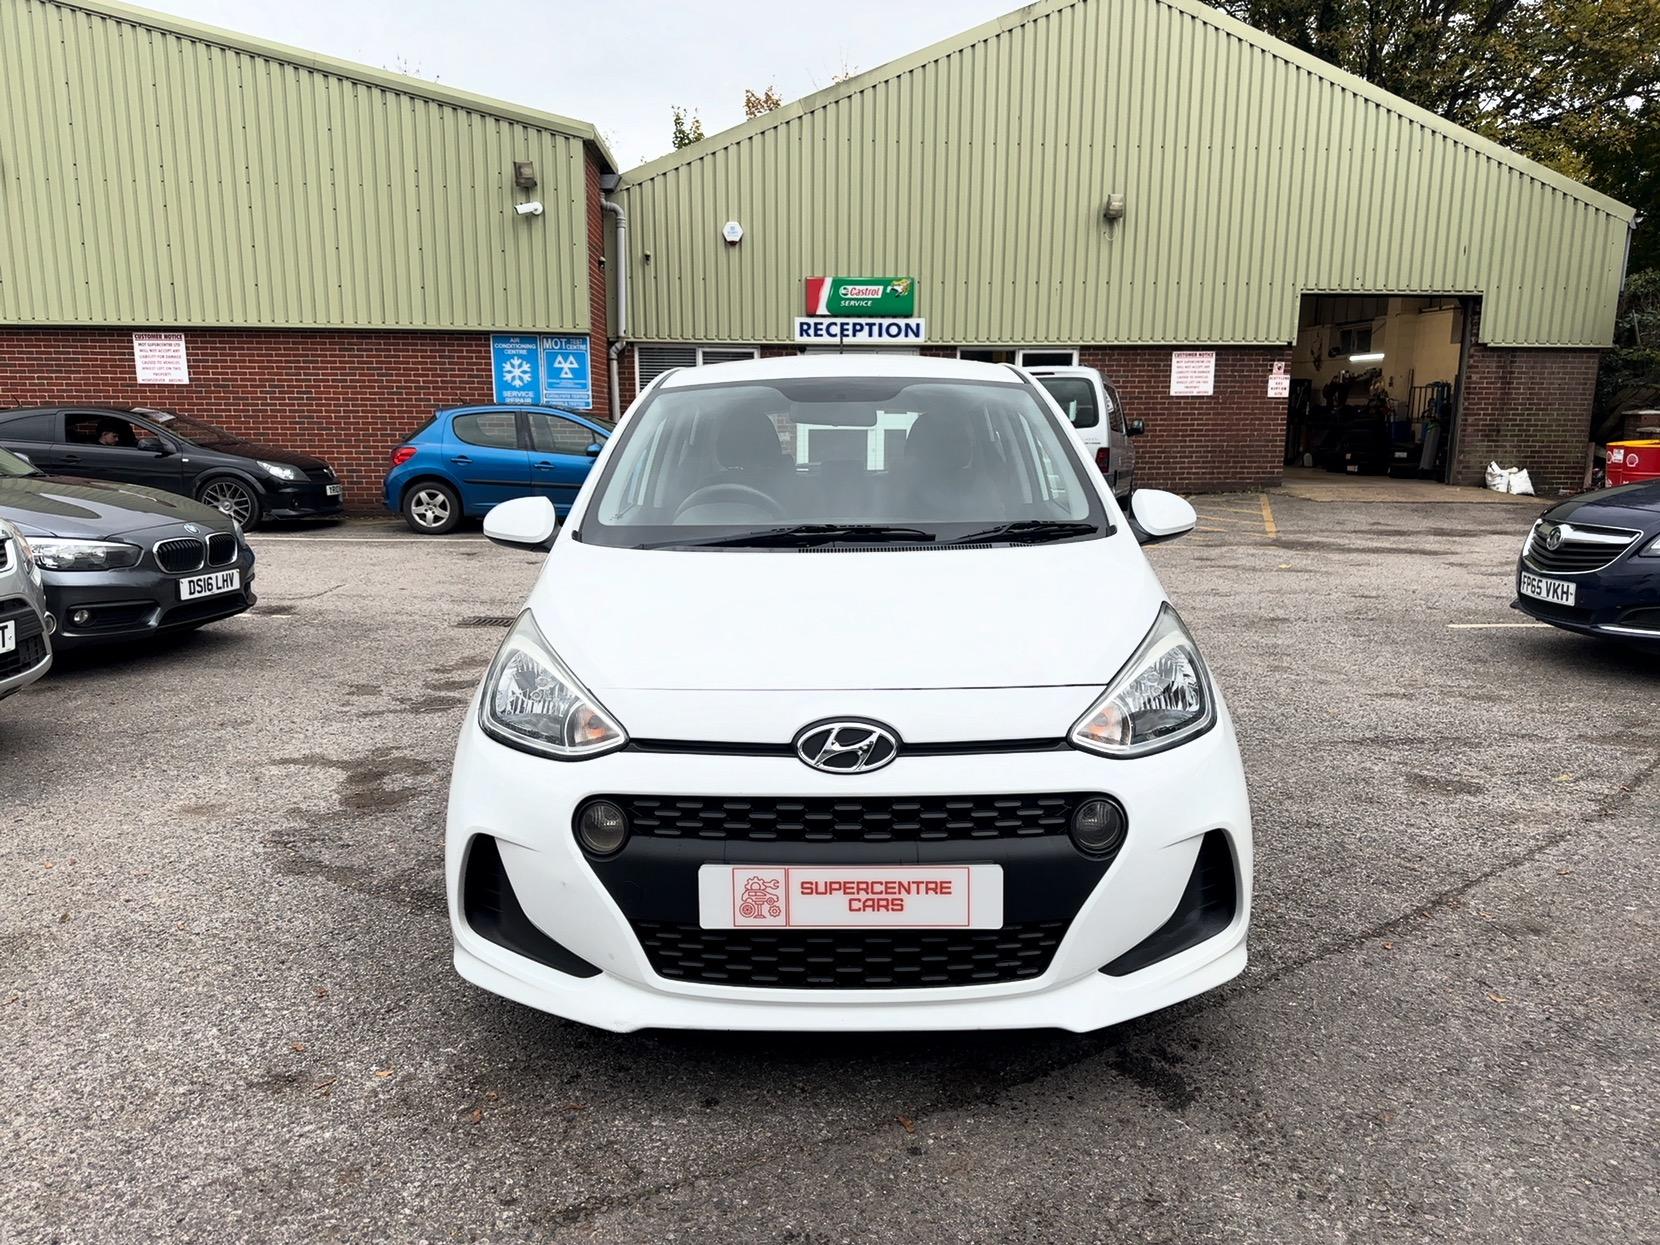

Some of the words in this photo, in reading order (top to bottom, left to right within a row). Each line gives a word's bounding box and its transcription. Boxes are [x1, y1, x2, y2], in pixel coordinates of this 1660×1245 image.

[850, 287, 880, 297] Castrol
[799, 322, 920, 338] RECEPTION
[543, 338, 567, 350] MOT
[188, 576, 214, 596] DS16
[215, 572, 235, 590] LHV
[1522, 574, 1542, 596] FP65
[1545, 580, 1570, 602] VKH
[800, 880, 952, 896] SUPERCENTRE
[848, 897, 904, 912] CARS
